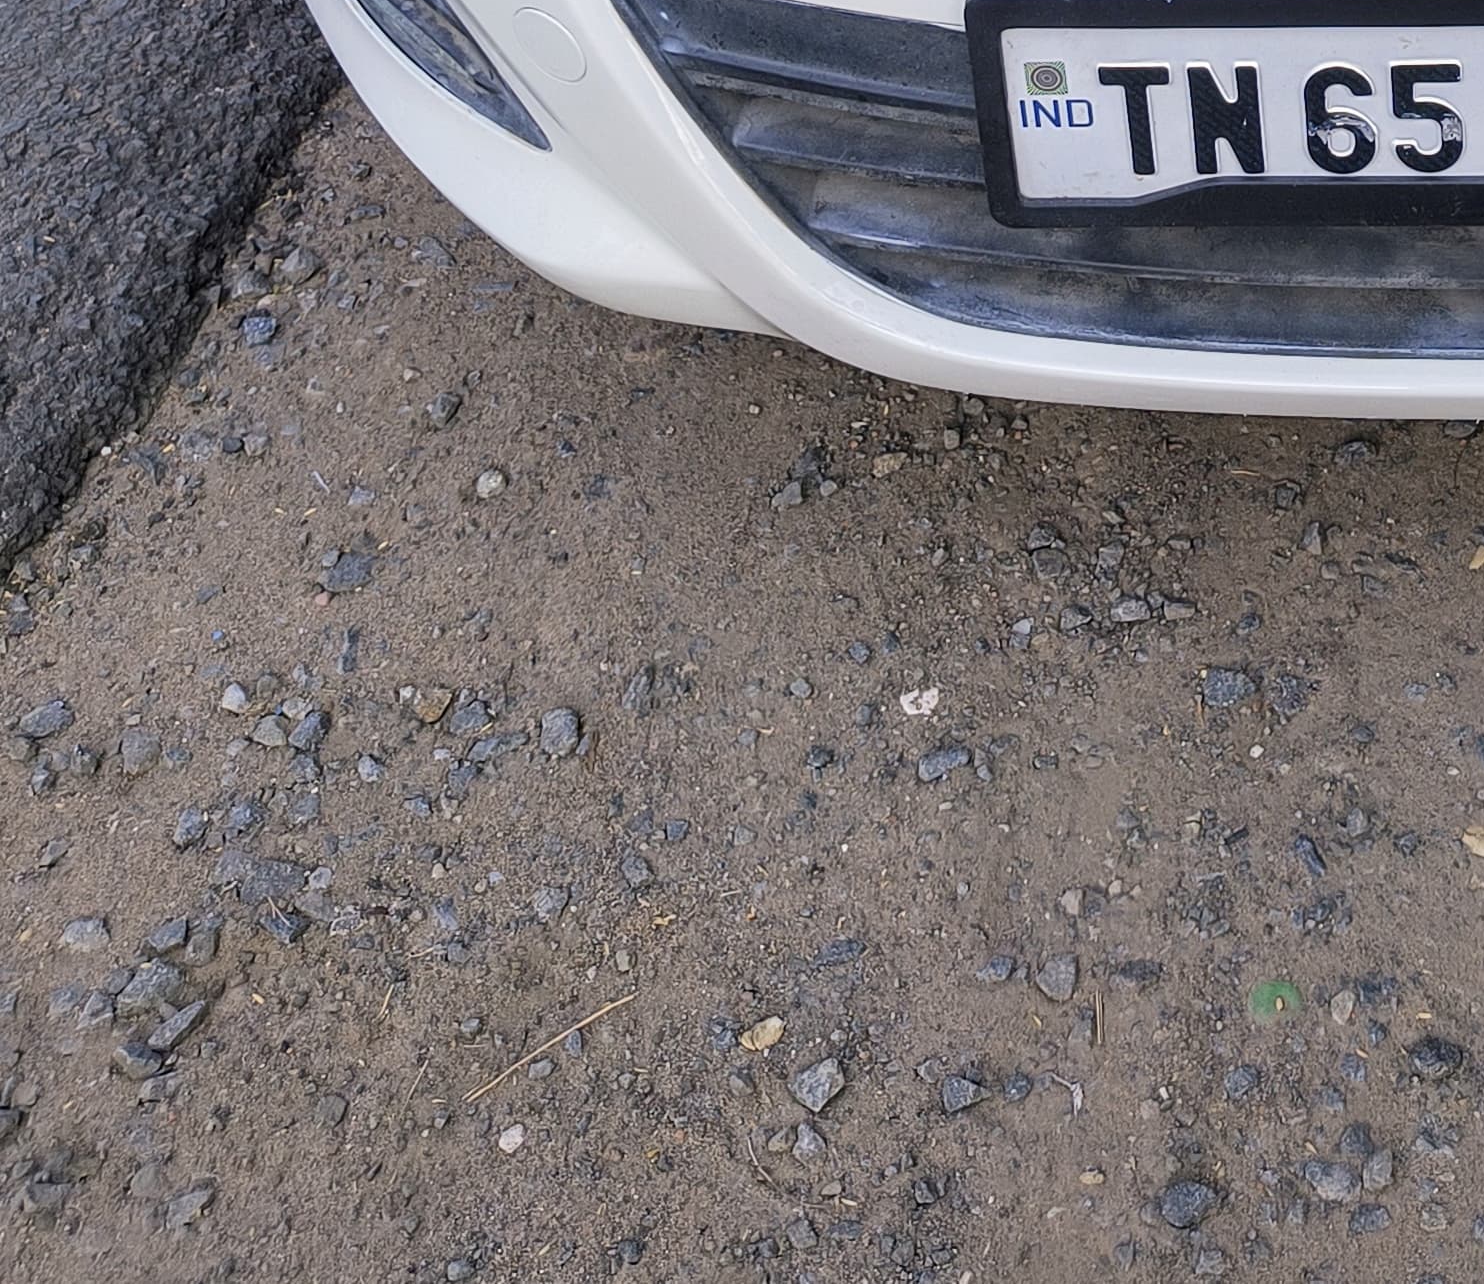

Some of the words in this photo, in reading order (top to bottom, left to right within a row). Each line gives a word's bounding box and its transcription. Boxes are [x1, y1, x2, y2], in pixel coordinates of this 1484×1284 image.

[1018, 99, 1094, 128] IND
[1098, 63, 1266, 175] TN
[1303, 62, 1464, 175] 65
